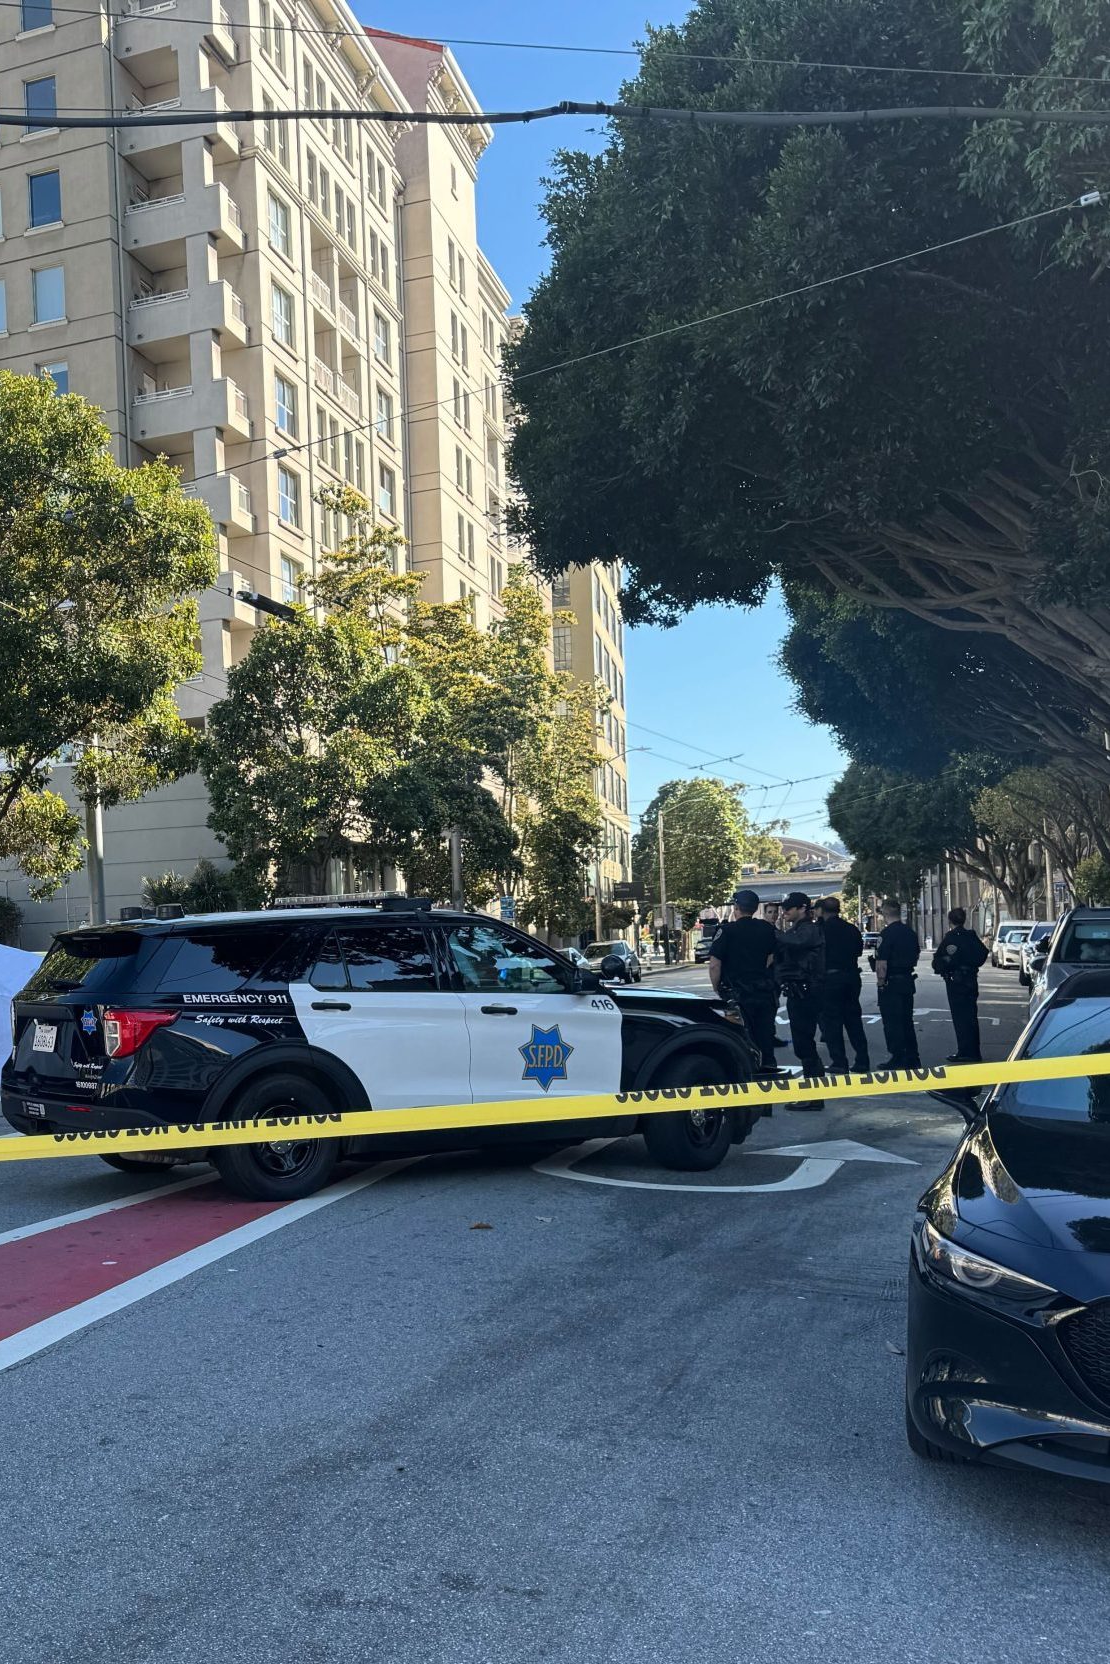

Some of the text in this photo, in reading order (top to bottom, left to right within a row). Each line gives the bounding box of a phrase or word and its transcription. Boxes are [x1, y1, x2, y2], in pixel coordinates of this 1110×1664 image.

[183, 994, 288, 1004] EMERGENCY 911
[591, 999, 614, 1011] 416
[194, 1014, 284, 1026] Safety with Respect
